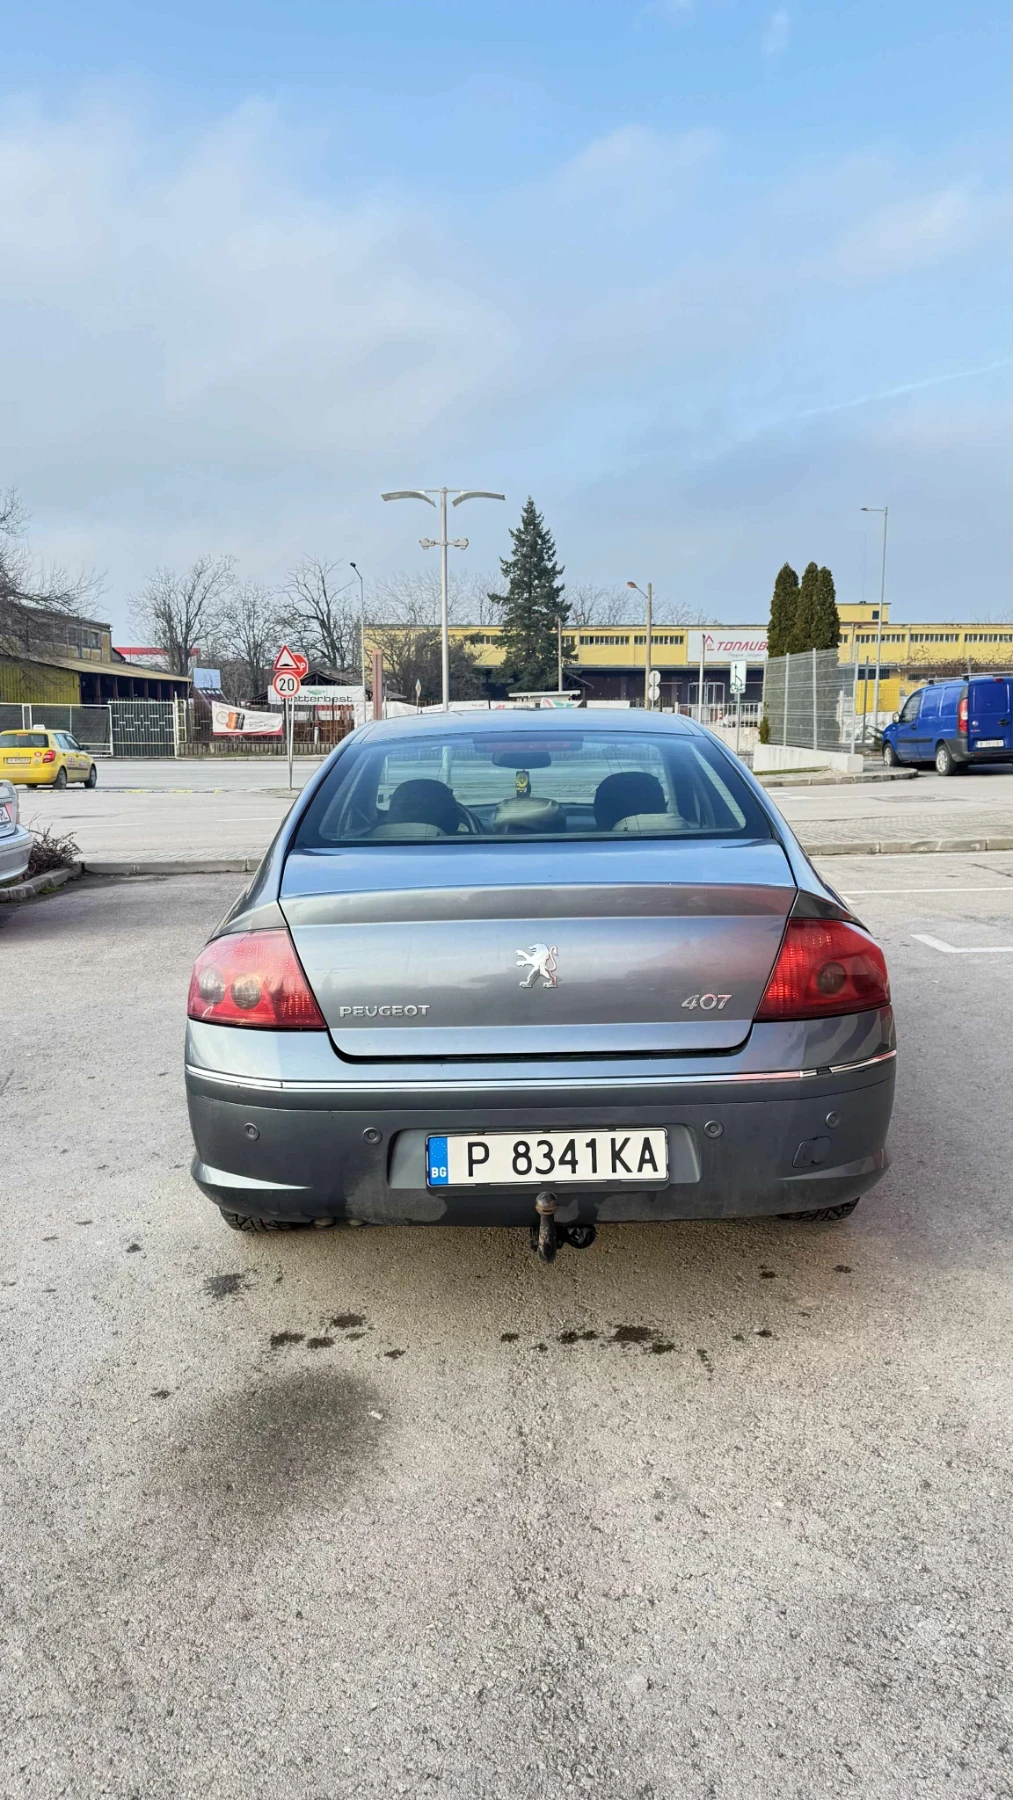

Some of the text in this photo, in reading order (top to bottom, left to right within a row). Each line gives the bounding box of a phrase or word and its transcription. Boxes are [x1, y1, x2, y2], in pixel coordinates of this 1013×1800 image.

[717, 641, 768, 651] ТОПЛИВ
[279, 678, 295, 691] 20
[681, 993, 732, 1010] 407
[339, 1005, 430, 1018] PEUGEOT
[467, 1141, 490, 1178] P
[431, 1167, 447, 1178] BG
